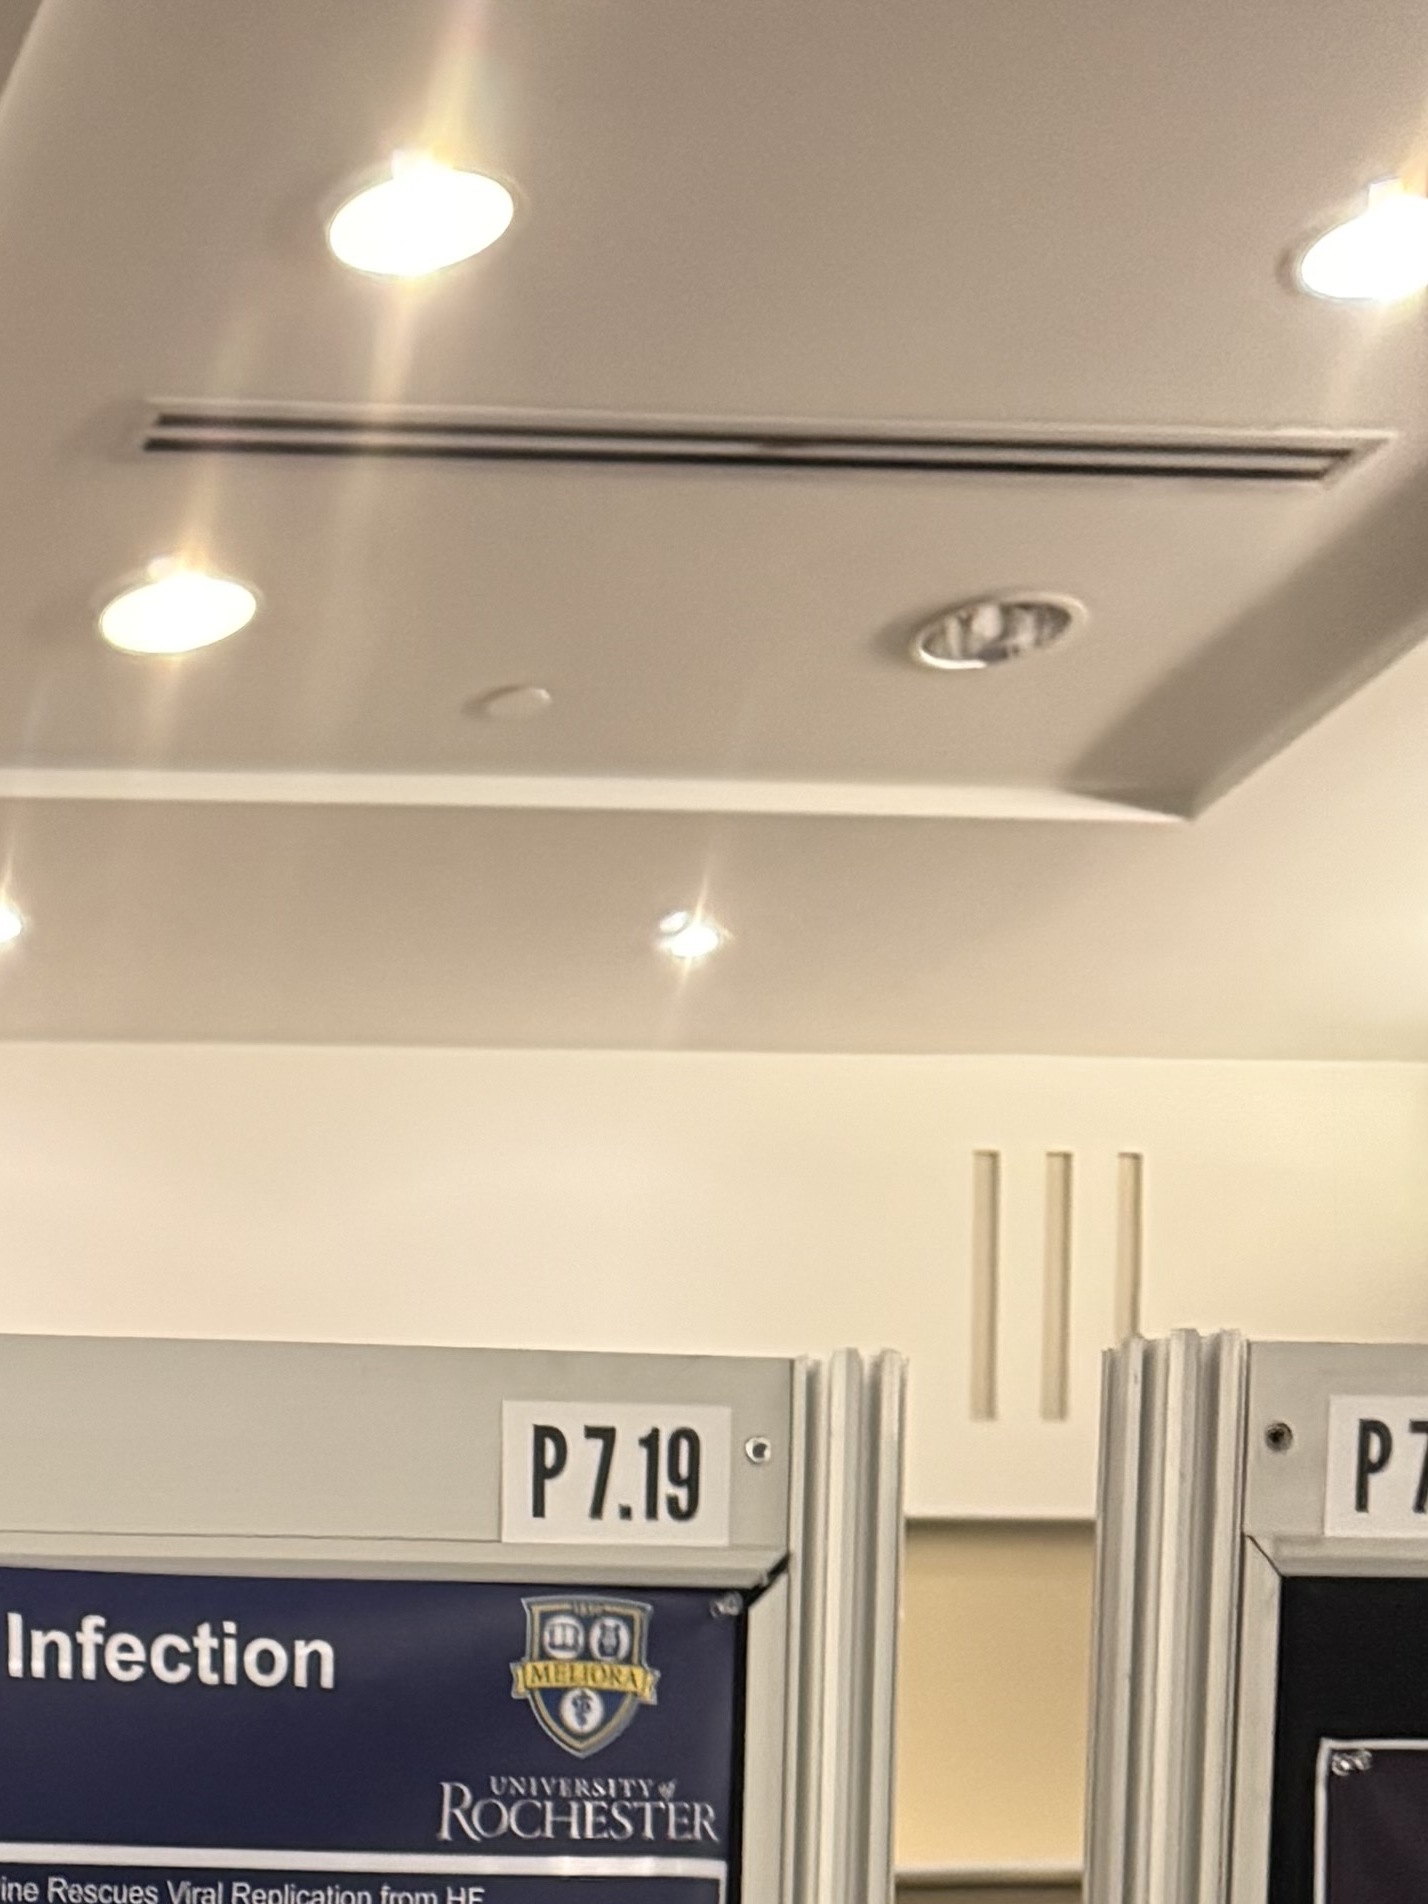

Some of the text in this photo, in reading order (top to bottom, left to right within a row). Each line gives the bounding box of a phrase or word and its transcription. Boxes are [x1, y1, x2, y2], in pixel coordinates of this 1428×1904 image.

[532, 1424, 701, 1521] P 7.19
[1355, 1418, 1393, 1514] P
[7, 1612, 335, 1688] Infection
[531, 1663, 638, 1689] MELIORA
[436, 1781, 721, 1842] ROCHESTER
[489, 1775, 654, 1799] UNIVERSITY
